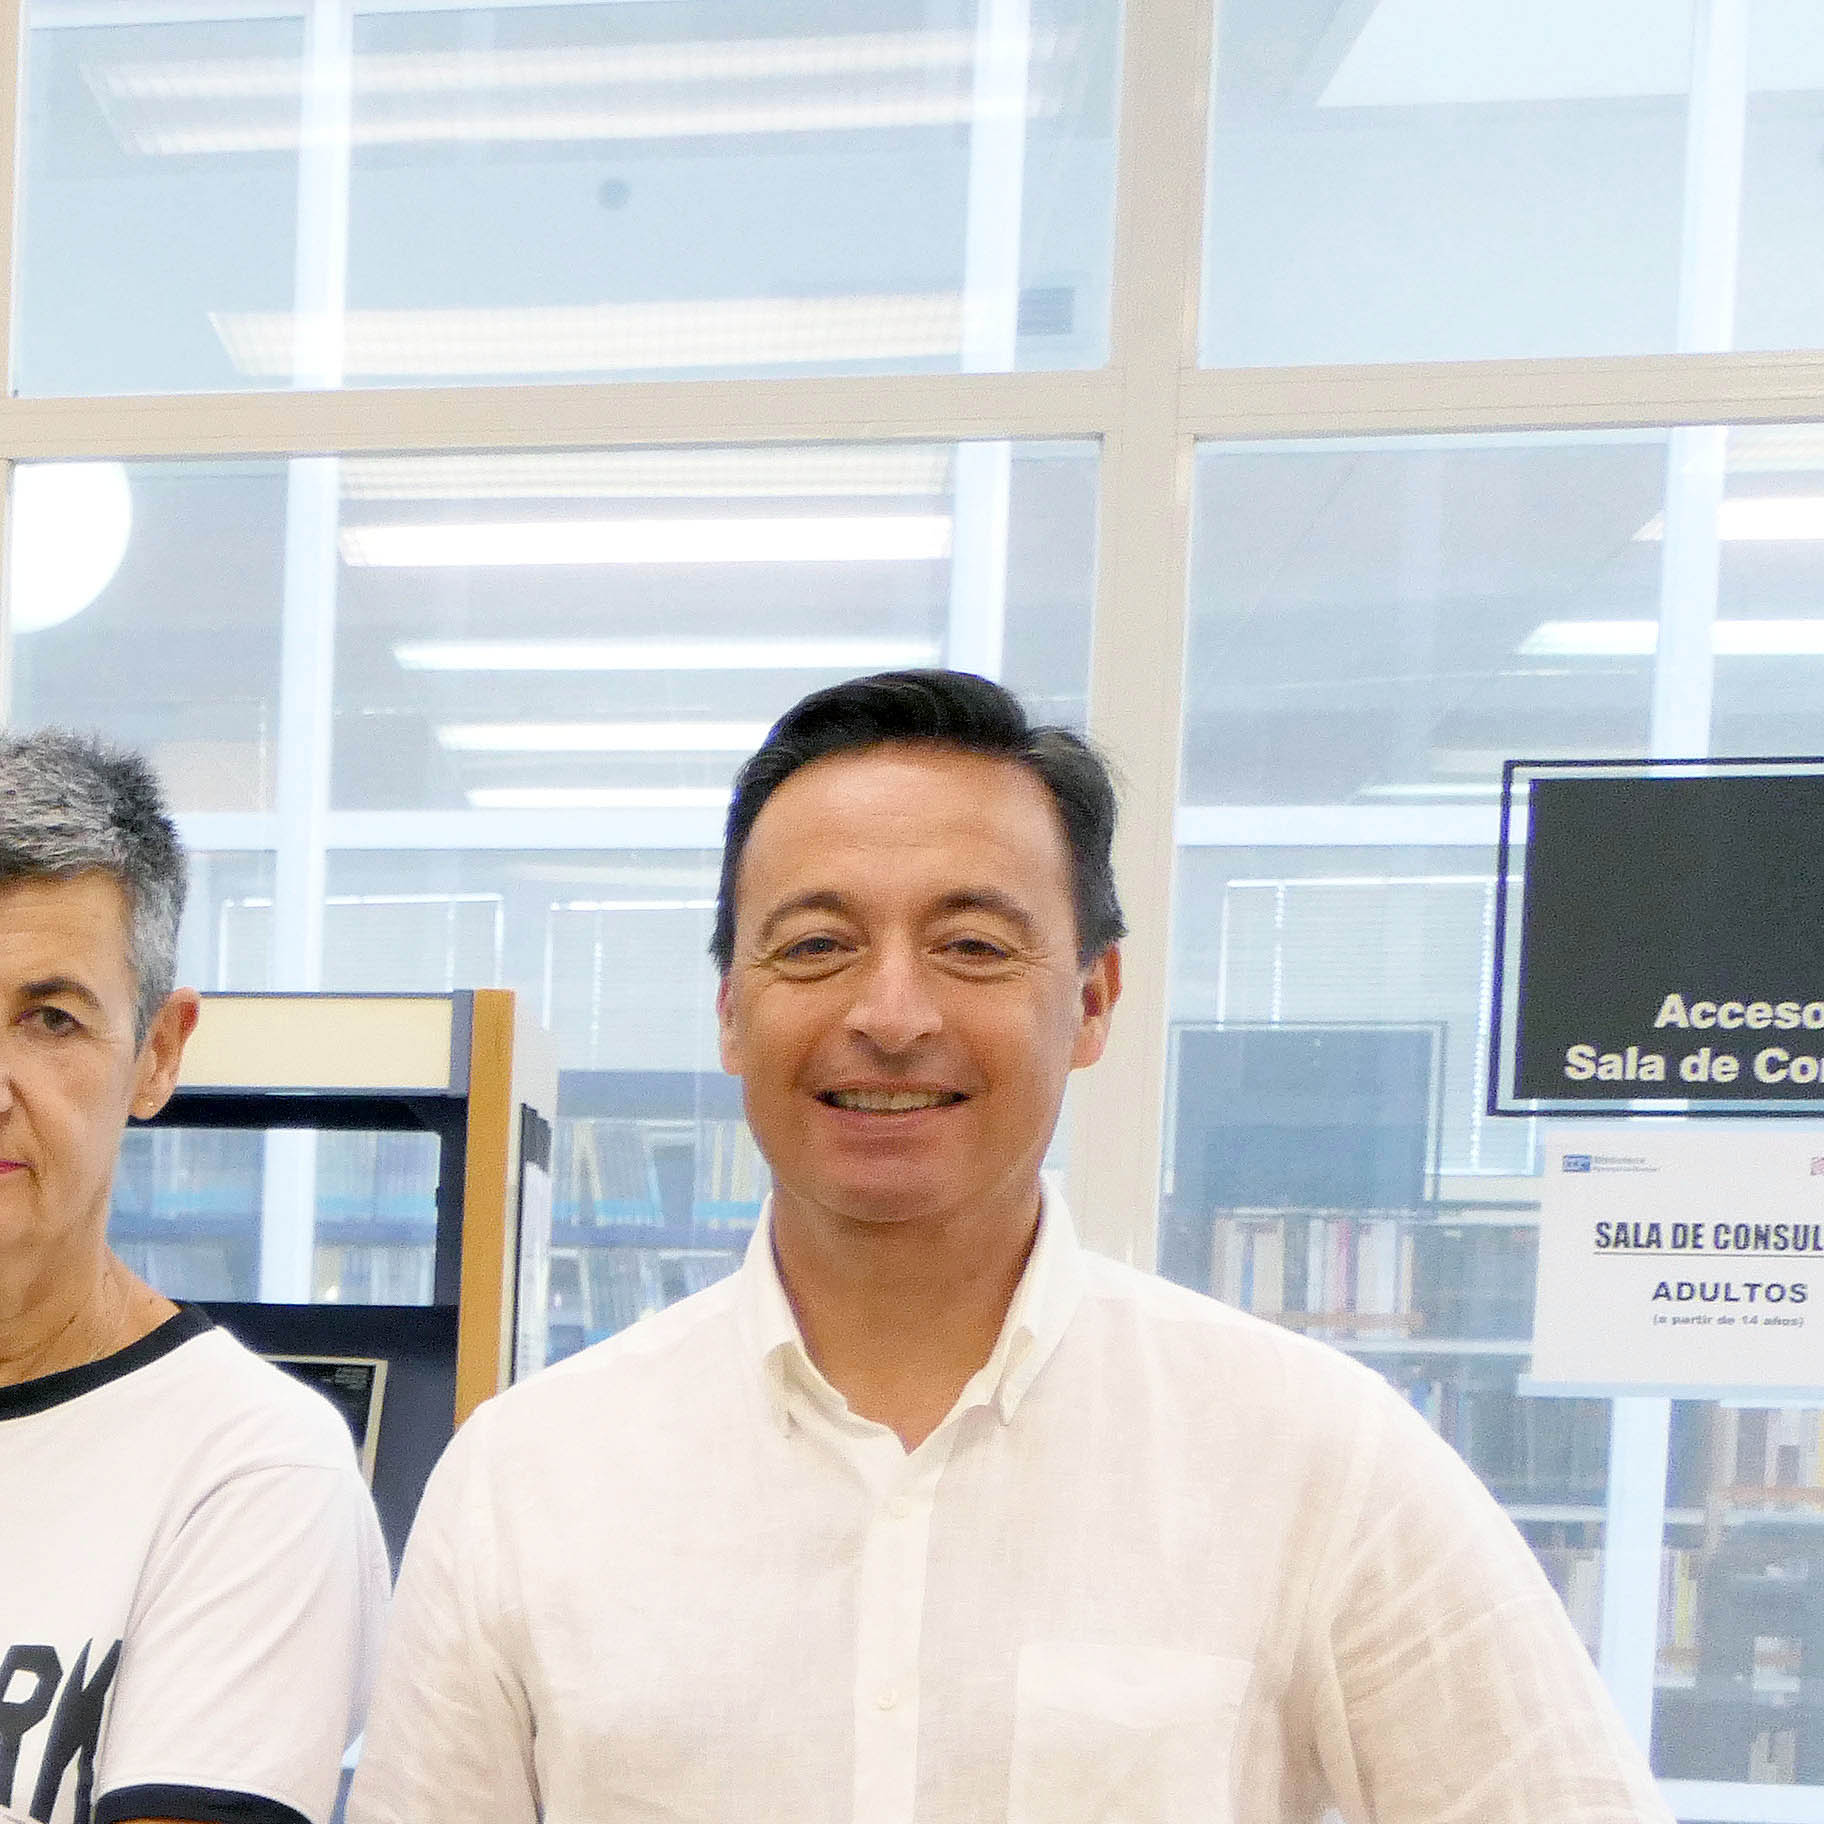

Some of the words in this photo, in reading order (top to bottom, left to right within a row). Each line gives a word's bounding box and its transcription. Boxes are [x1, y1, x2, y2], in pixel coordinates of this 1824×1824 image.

[1654, 993, 1824, 1029] Acceso
[1565, 1044, 1665, 1081] Sala
[1680, 1048, 1740, 1082] de
[1753, 1048, 1824, 1083] Co
[1595, 1221, 1662, 1249] SALA
[1671, 1222, 1705, 1249] DE
[1714, 1223, 1824, 1252] CONSUL
[1652, 1281, 1809, 1303] ADULTOS
